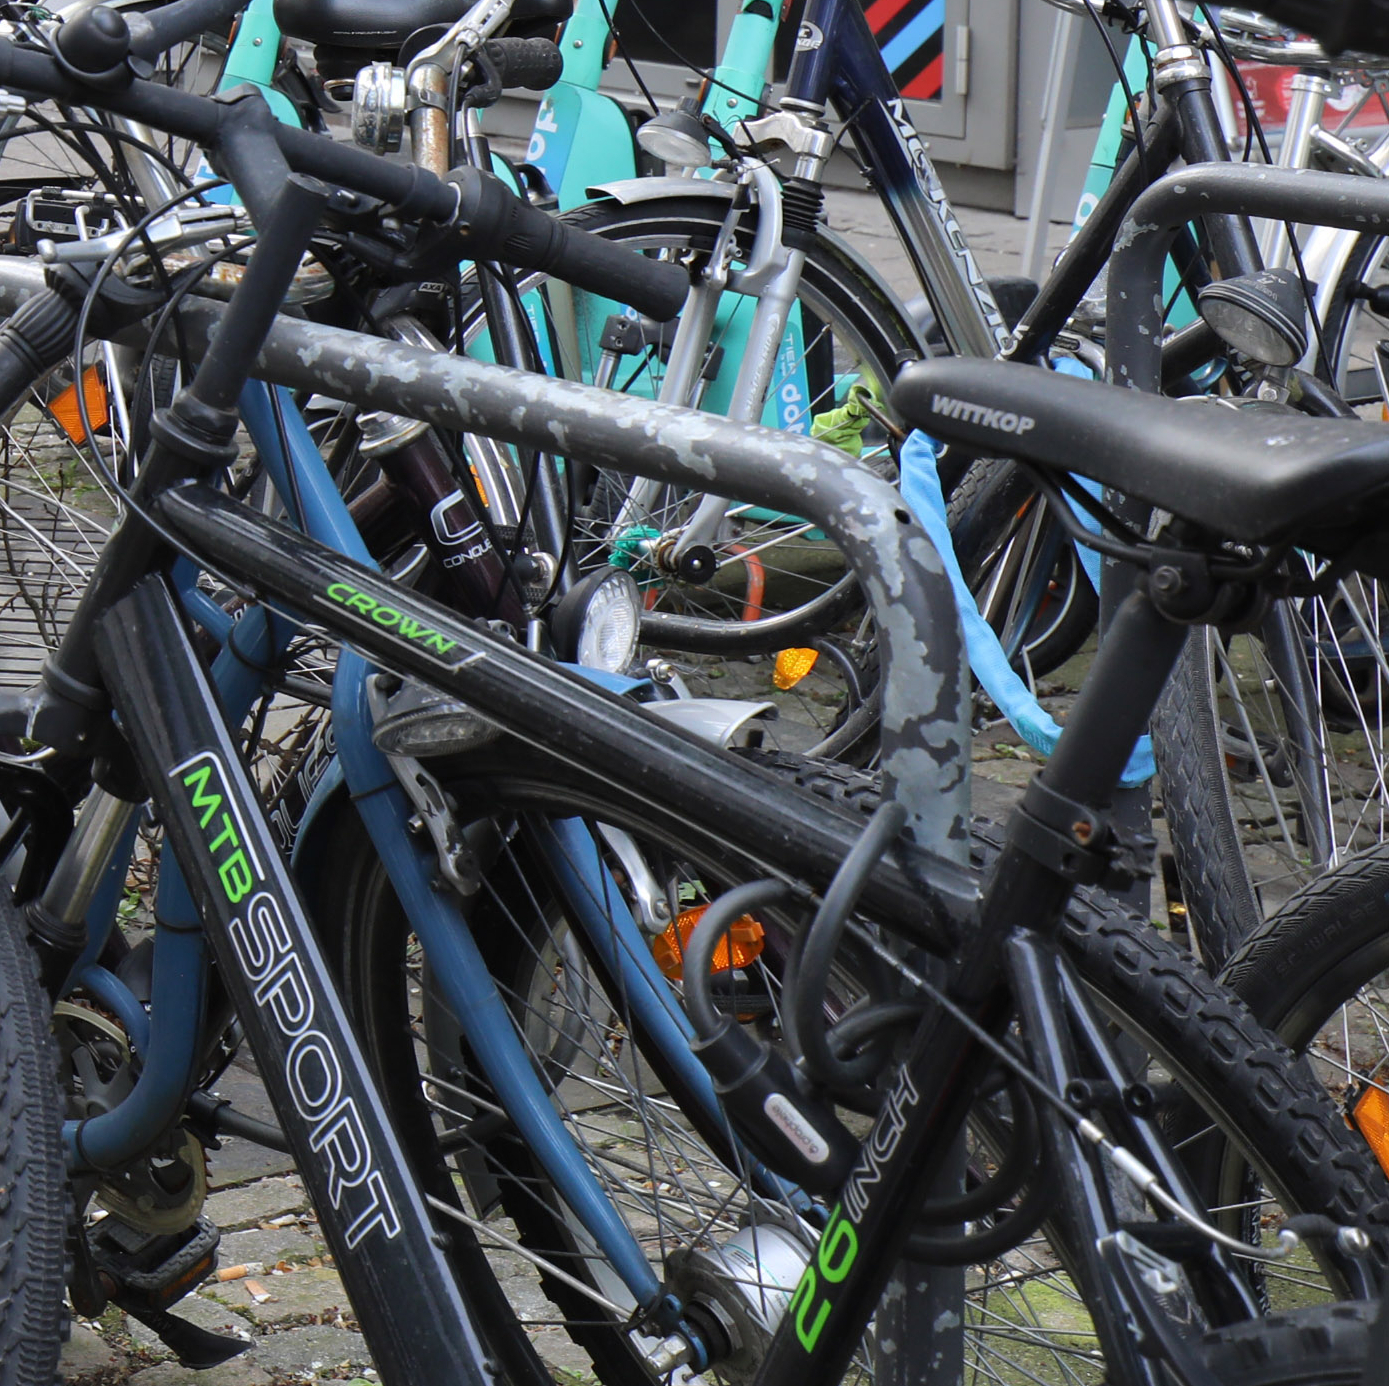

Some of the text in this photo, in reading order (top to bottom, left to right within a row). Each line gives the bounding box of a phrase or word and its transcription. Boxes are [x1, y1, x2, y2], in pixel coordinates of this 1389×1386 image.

[931, 393, 1036, 437] WITTKOP
[326, 582, 459, 656] CROWN
[842, 1062, 920, 1226] INCH
